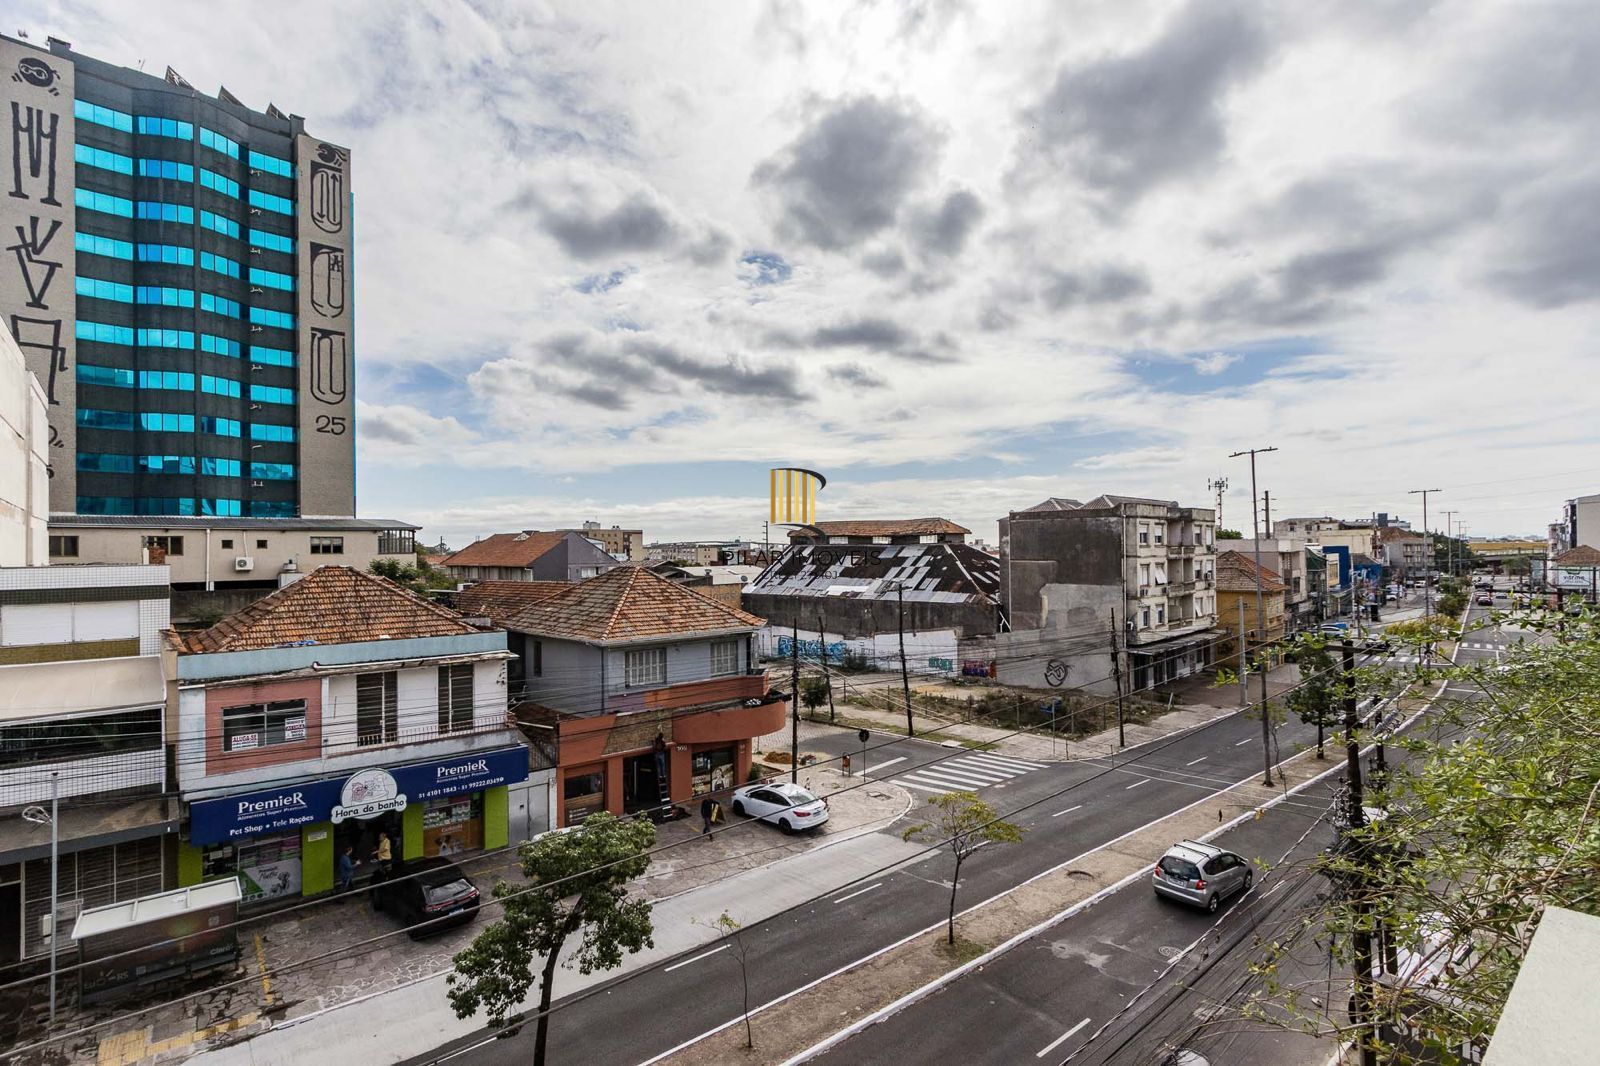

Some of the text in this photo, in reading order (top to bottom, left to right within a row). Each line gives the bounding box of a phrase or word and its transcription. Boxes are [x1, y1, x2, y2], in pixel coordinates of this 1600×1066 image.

[315, 415, 346, 435] 25
[437, 760, 489, 777] PremieR
[238, 791, 306, 813] PremieR
[335, 799, 404, 818] Hora do banho
[229, 828, 242, 836] Pet
[244, 825, 263, 834] Shop
[272, 819, 287, 828] Tele
